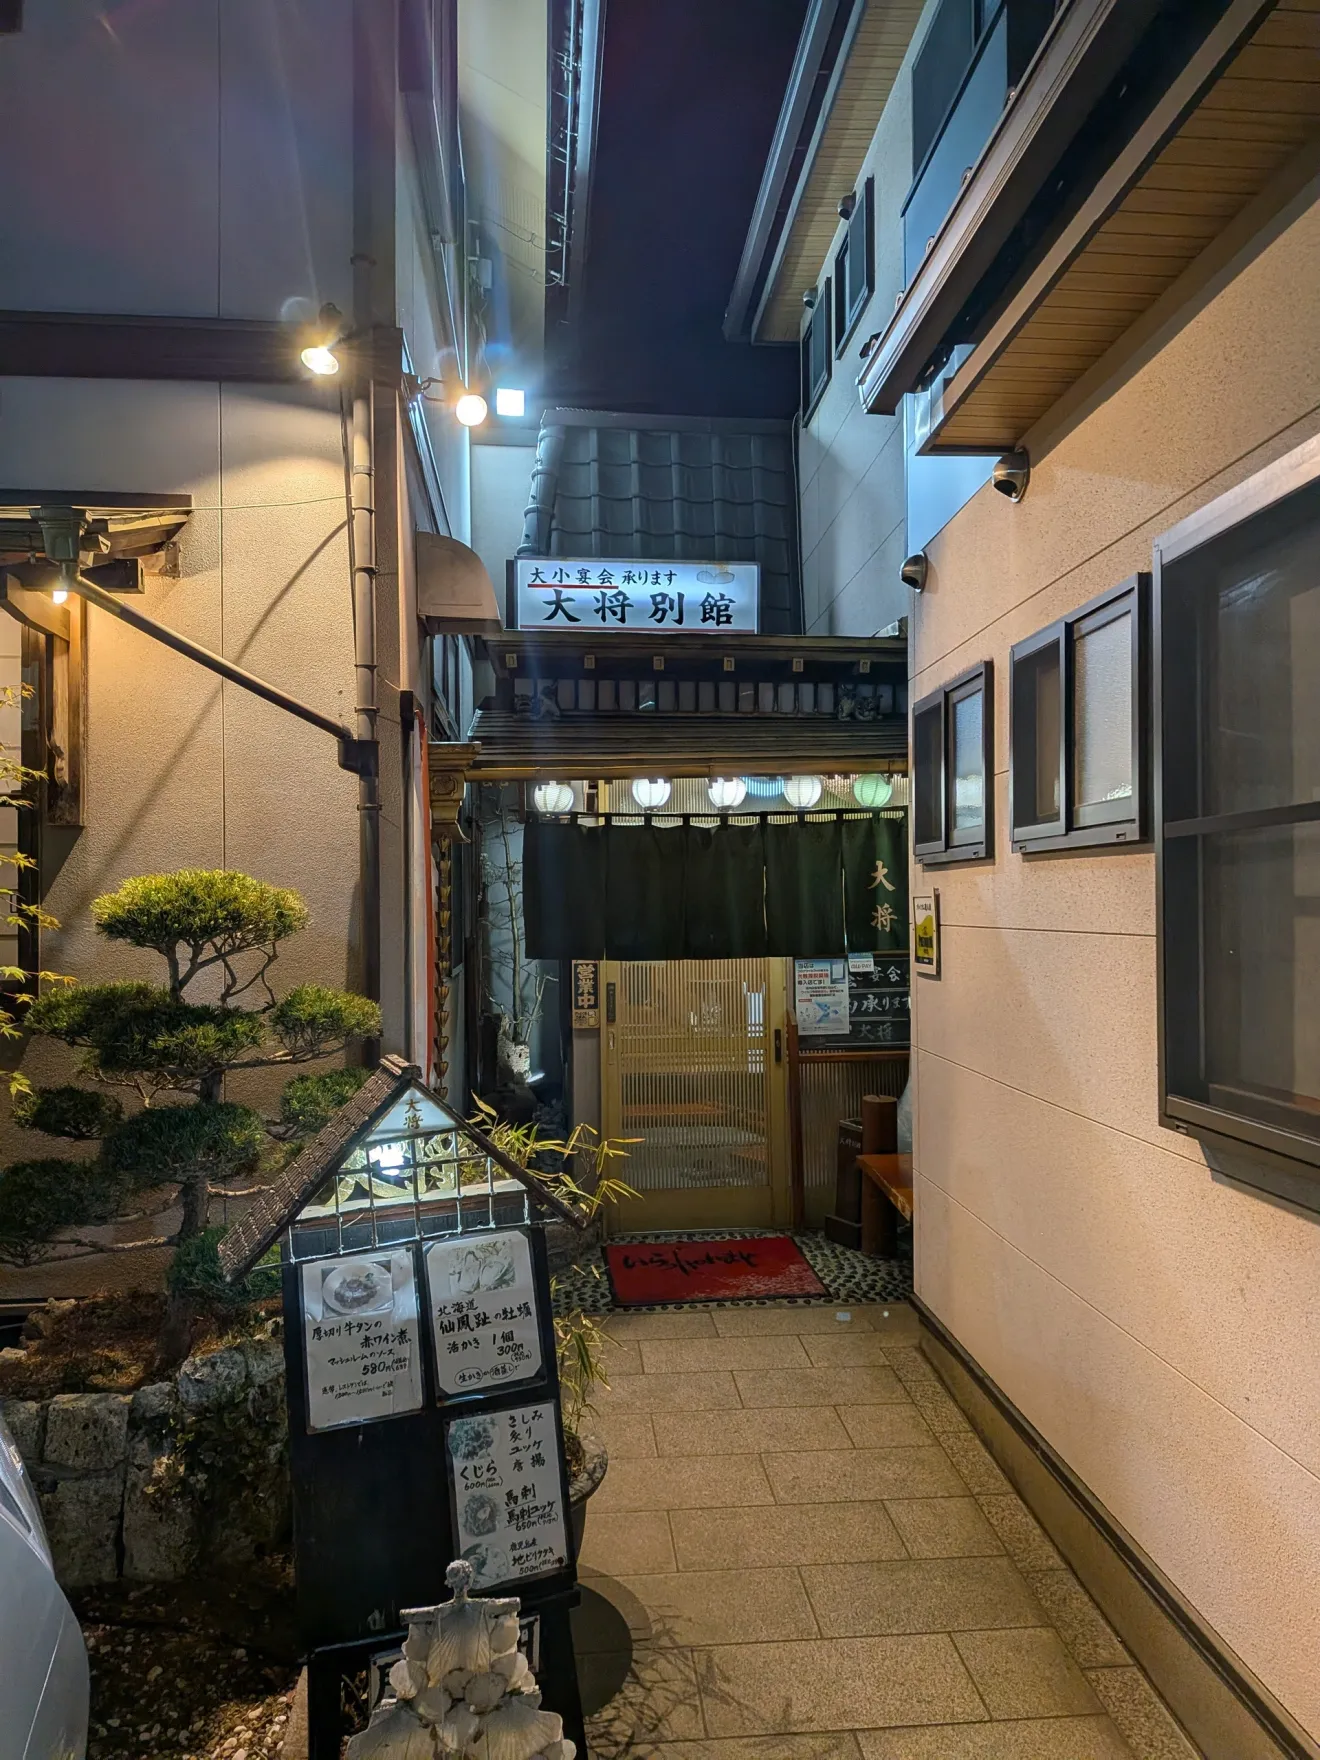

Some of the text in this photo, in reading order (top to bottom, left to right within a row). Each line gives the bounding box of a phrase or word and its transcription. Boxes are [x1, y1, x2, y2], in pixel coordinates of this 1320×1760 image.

[529, 567, 678, 586] 大小宴会 承ります
[542, 589, 736, 626] 大将別館
[867, 860, 897, 932] 大将
[576, 964, 595, 1008] 営業中
[404, 1098, 424, 1130] 大将
[437, 1299, 478, 1317] 北海道
[446, 1337, 480, 1354] 活かき
[497, 1343, 523, 1356] 300円
[508, 1410, 544, 1428] さしみ
[509, 1440, 543, 1455] ユッケ
[460, 1459, 498, 1480] くじら
[505, 1483, 537, 1507] 馬刺
[506, 1500, 556, 1525] 馬刺ユッケ
